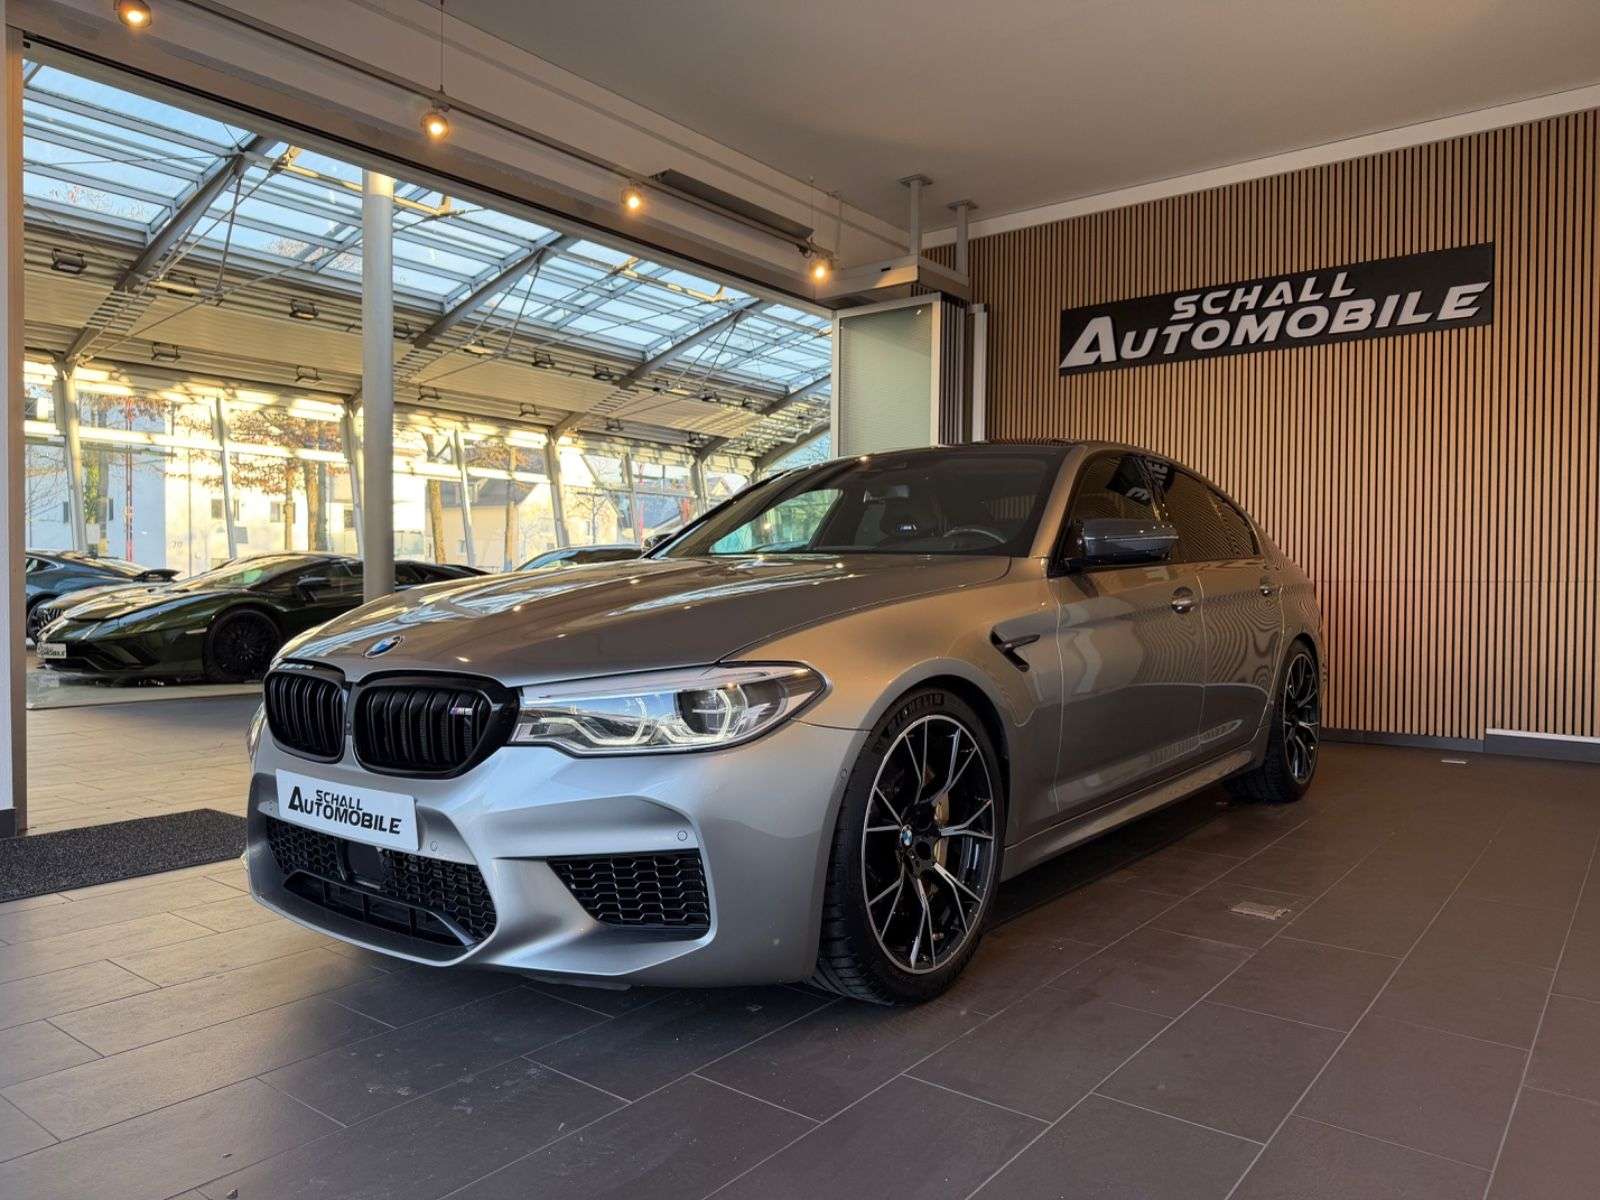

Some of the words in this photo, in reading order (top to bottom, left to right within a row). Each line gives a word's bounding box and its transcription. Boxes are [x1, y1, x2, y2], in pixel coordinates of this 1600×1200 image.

[1170, 271, 1356, 321] SCHALL
[1060, 281, 1491, 368] AUTOMOBILE
[287, 785, 403, 835] AUTOMOBILE
[314, 789, 364, 812] SCHALL
